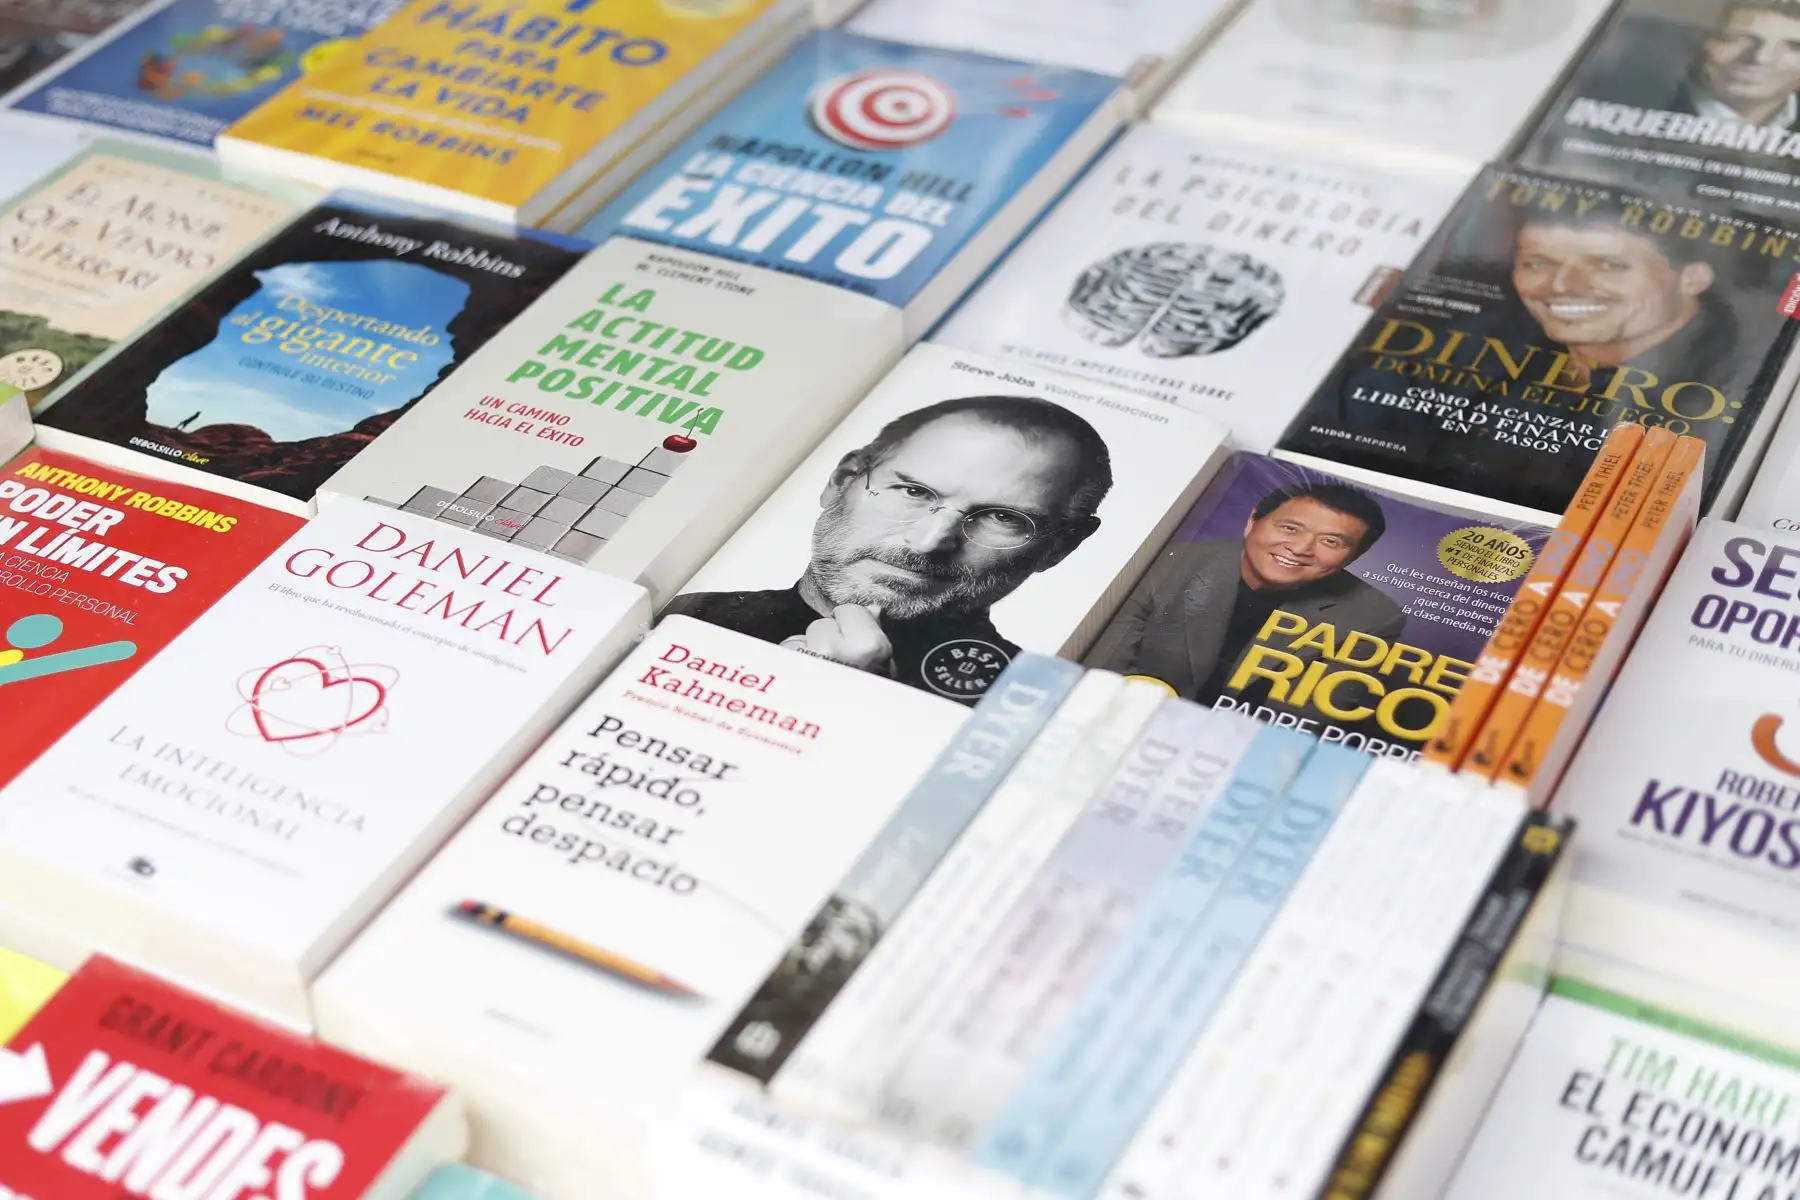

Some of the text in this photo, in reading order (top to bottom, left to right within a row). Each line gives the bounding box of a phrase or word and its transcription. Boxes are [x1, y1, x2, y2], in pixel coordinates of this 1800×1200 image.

[682, 151, 736, 178] LA
[884, 189, 955, 226] DEL
[314, 217, 526, 279] Anthony Robbins
[274, 292, 440, 348] Despertando
[597, 282, 656, 313] LA
[229, 310, 419, 372] al gigante
[537, 333, 720, 397] MENTAL
[566, 309, 764, 371] ACTITUD
[299, 350, 398, 386] interior
[952, 360, 995, 378] Steve
[997, 373, 1036, 389] Jobs
[1044, 383, 1094, 404] Walter
[1096, 396, 1171, 424] Isaacson
[1365, 318, 1744, 424] DINERO:
[1370, 355, 1508, 399] DOMINA
[1519, 386, 1562, 408] EL
[463, 408, 512, 429] HACIA
[514, 421, 535, 435] EL
[479, 395, 572, 427] UN CAMINO
[505, 360, 724, 436] POSITIVA
[1352, 387, 1602, 453] LIBERTAD FINANC
[1406, 386, 1594, 438] CÓMO ALCANZAR
[129, 436, 183, 458] DEBOLSILLO
[1354, 433, 1408, 453] EMPRESA
[1441, 419, 1562, 454] EN PASOS
[0, 480, 125, 536] PODER
[16, 461, 237, 533] ANTHONY ROBBINS
[1576, 452, 1623, 513] PETER THIEL
[1611, 459, 1655, 522] PETER THIEL
[1642, 468, 1686, 531] PETER THIEL
[437, 500, 494, 521] DEBOLSILLO
[5, 556, 70, 583] CIENCIA
[15, 527, 188, 594] LÍMITES
[354, 522, 564, 607] DANIEL
[1445, 546, 1516, 577] #1 DE FINANZAS
[1446, 556, 1498, 581] PERSONALES
[1453, 540, 1521, 569] SIENDO EL LIBRO
[1462, 530, 1530, 561] 20 AÑOS
[1711, 537, 1800, 601] SE
[49, 587, 139, 626] PERSONAL
[281, 585, 303, 599] libro
[302, 592, 322, 607] que
[285, 548, 574, 656] GOLEMAN
[1362, 571, 1370, 579] a
[1371, 573, 1389, 584] sus
[1388, 573, 1417, 596] hijos
[1417, 585, 1452, 602] acerca
[1452, 592, 1471, 606] del
[1386, 563, 1515, 605] Qué les enseñan los ricos
[1402, 605, 1412, 615] la
[1412, 608, 1442, 624] clase
[1441, 615, 1477, 632] media
[1413, 596, 1502, 628] ¡que los pobres y
[658, 643, 776, 694] Daniel
[950, 647, 1000, 670] BEST
[1256, 608, 1475, 695] PADRE
[1689, 635, 1746, 658] PARA TU
[637, 665, 822, 740] Kahneman
[934, 664, 988, 690] SELLER
[1227, 643, 1453, 741] RICO
[109, 724, 146, 751] LA
[588, 714, 739, 781] Pensar
[941, 682, 1048, 781] DYER
[560, 747, 707, 819] rápido,
[521, 782, 685, 846] pensar
[1603, 1035, 1677, 1091] TIM
[1558, 1070, 1605, 1117] EL
